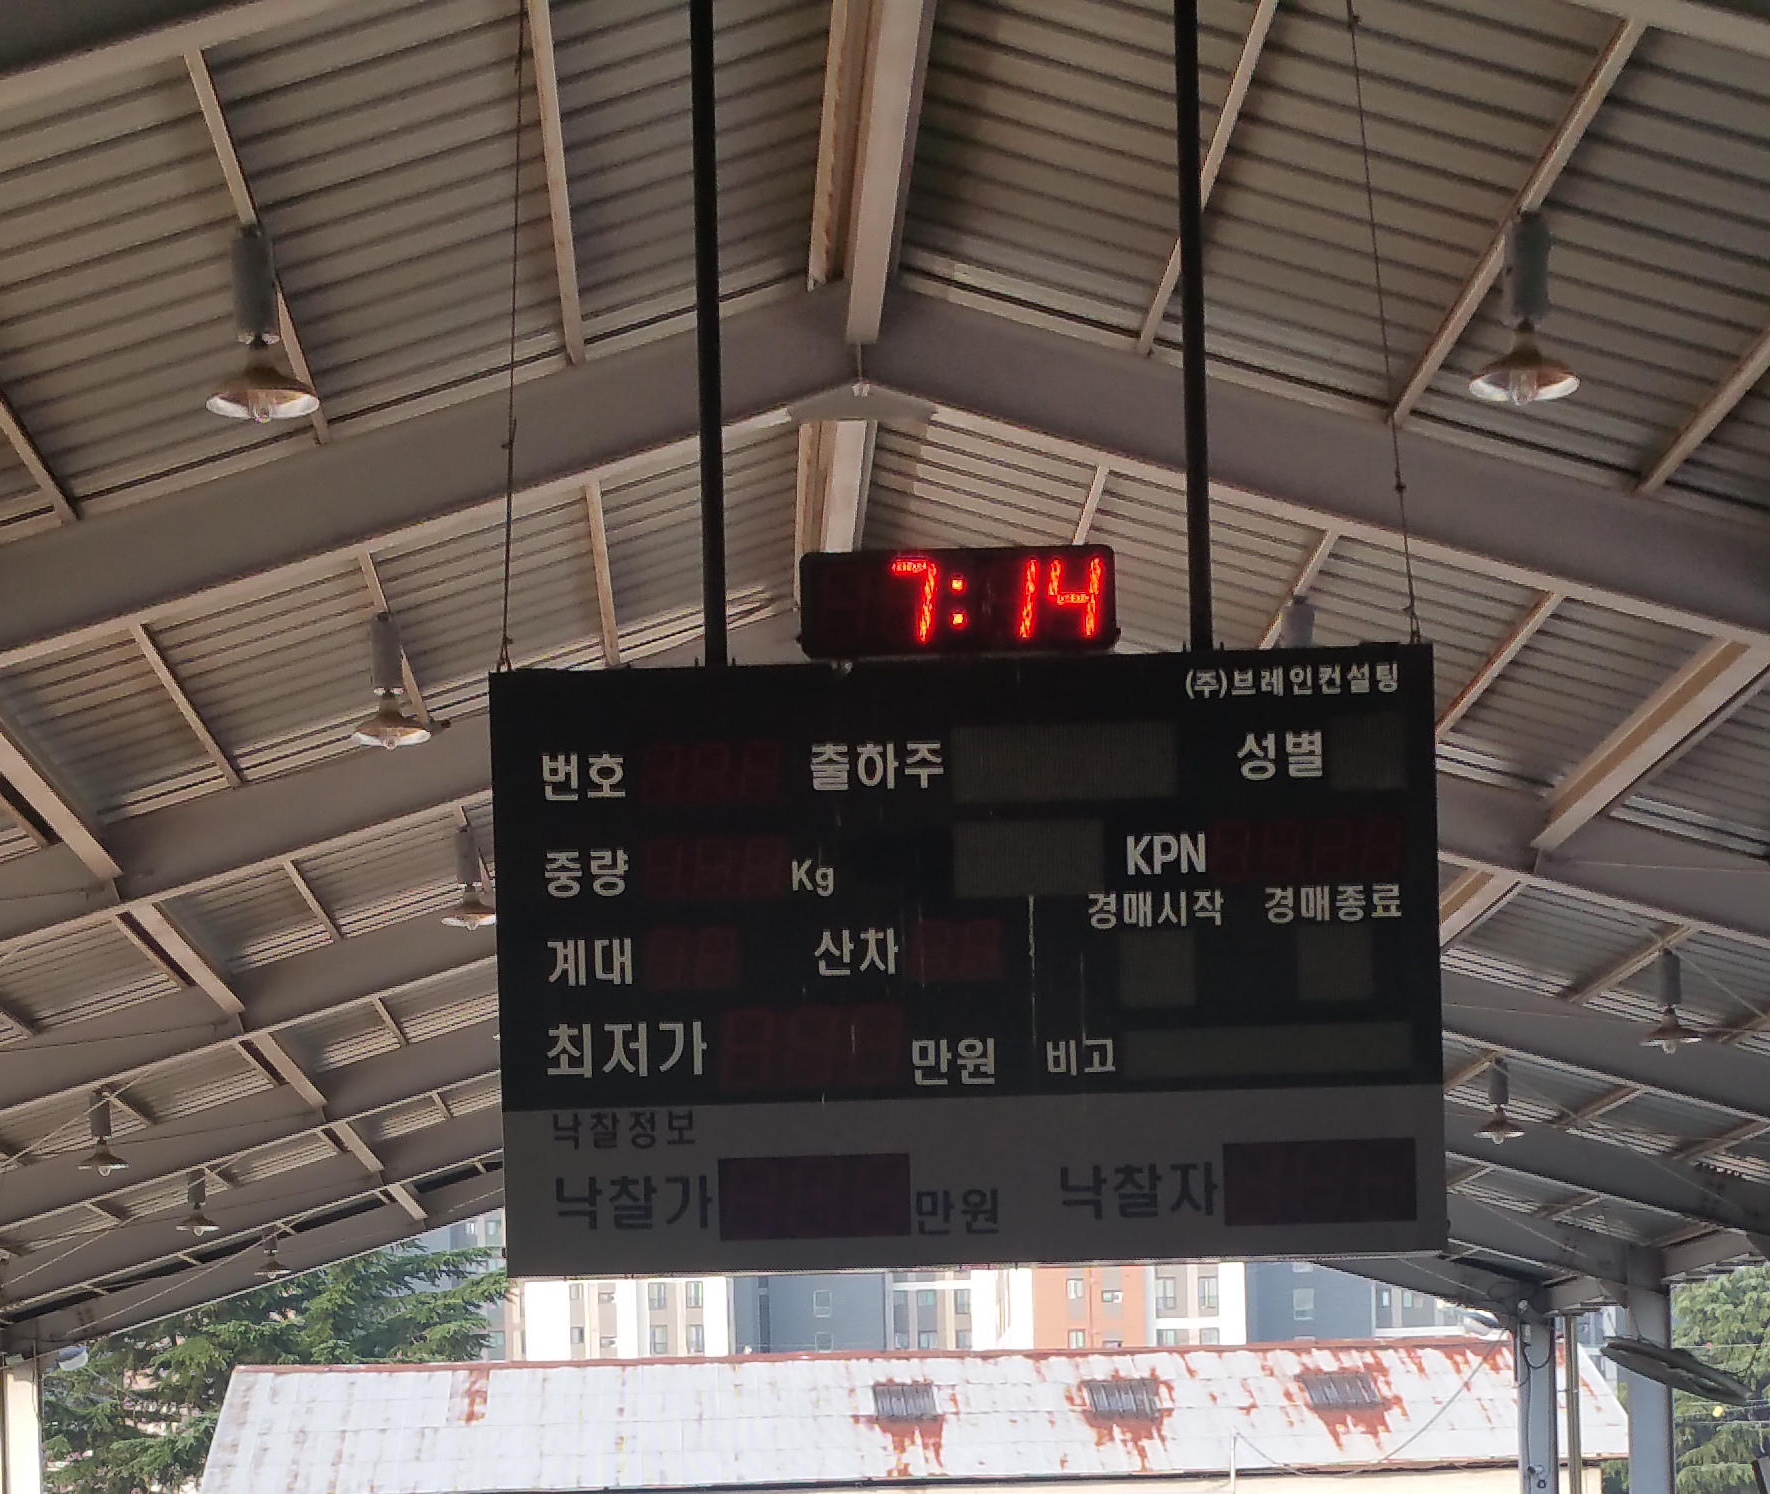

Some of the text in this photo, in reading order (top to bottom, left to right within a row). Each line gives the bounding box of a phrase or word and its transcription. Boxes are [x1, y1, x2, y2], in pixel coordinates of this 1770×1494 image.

[891, 555, 1103, 644] 7:14
[1185, 661, 1400, 701] (주)브레인컨설팅
[542, 753, 628, 801] 번호
[809, 741, 945, 792] 출하주
[1237, 729, 1324, 781] 성별
[543, 847, 629, 898] 중량
[791, 859, 835, 896] Kg
[1126, 833, 1208, 876] KPN
[1087, 890, 1224, 930] 경매시작
[1264, 883, 1403, 924] 경매종료
[547, 936, 634, 986] 계대
[814, 929, 899, 976] 산차
[545, 1020, 707, 1078] 최저가
[912, 1037, 997, 1087] 만원
[1046, 1038, 1117, 1077] 비고
[552, 1108, 697, 1149] 낙찰정보
[554, 1173, 713, 1231] 낙찰가
[915, 1186, 1000, 1236] 만원
[1059, 1161, 1218, 1219] 낙찰자
